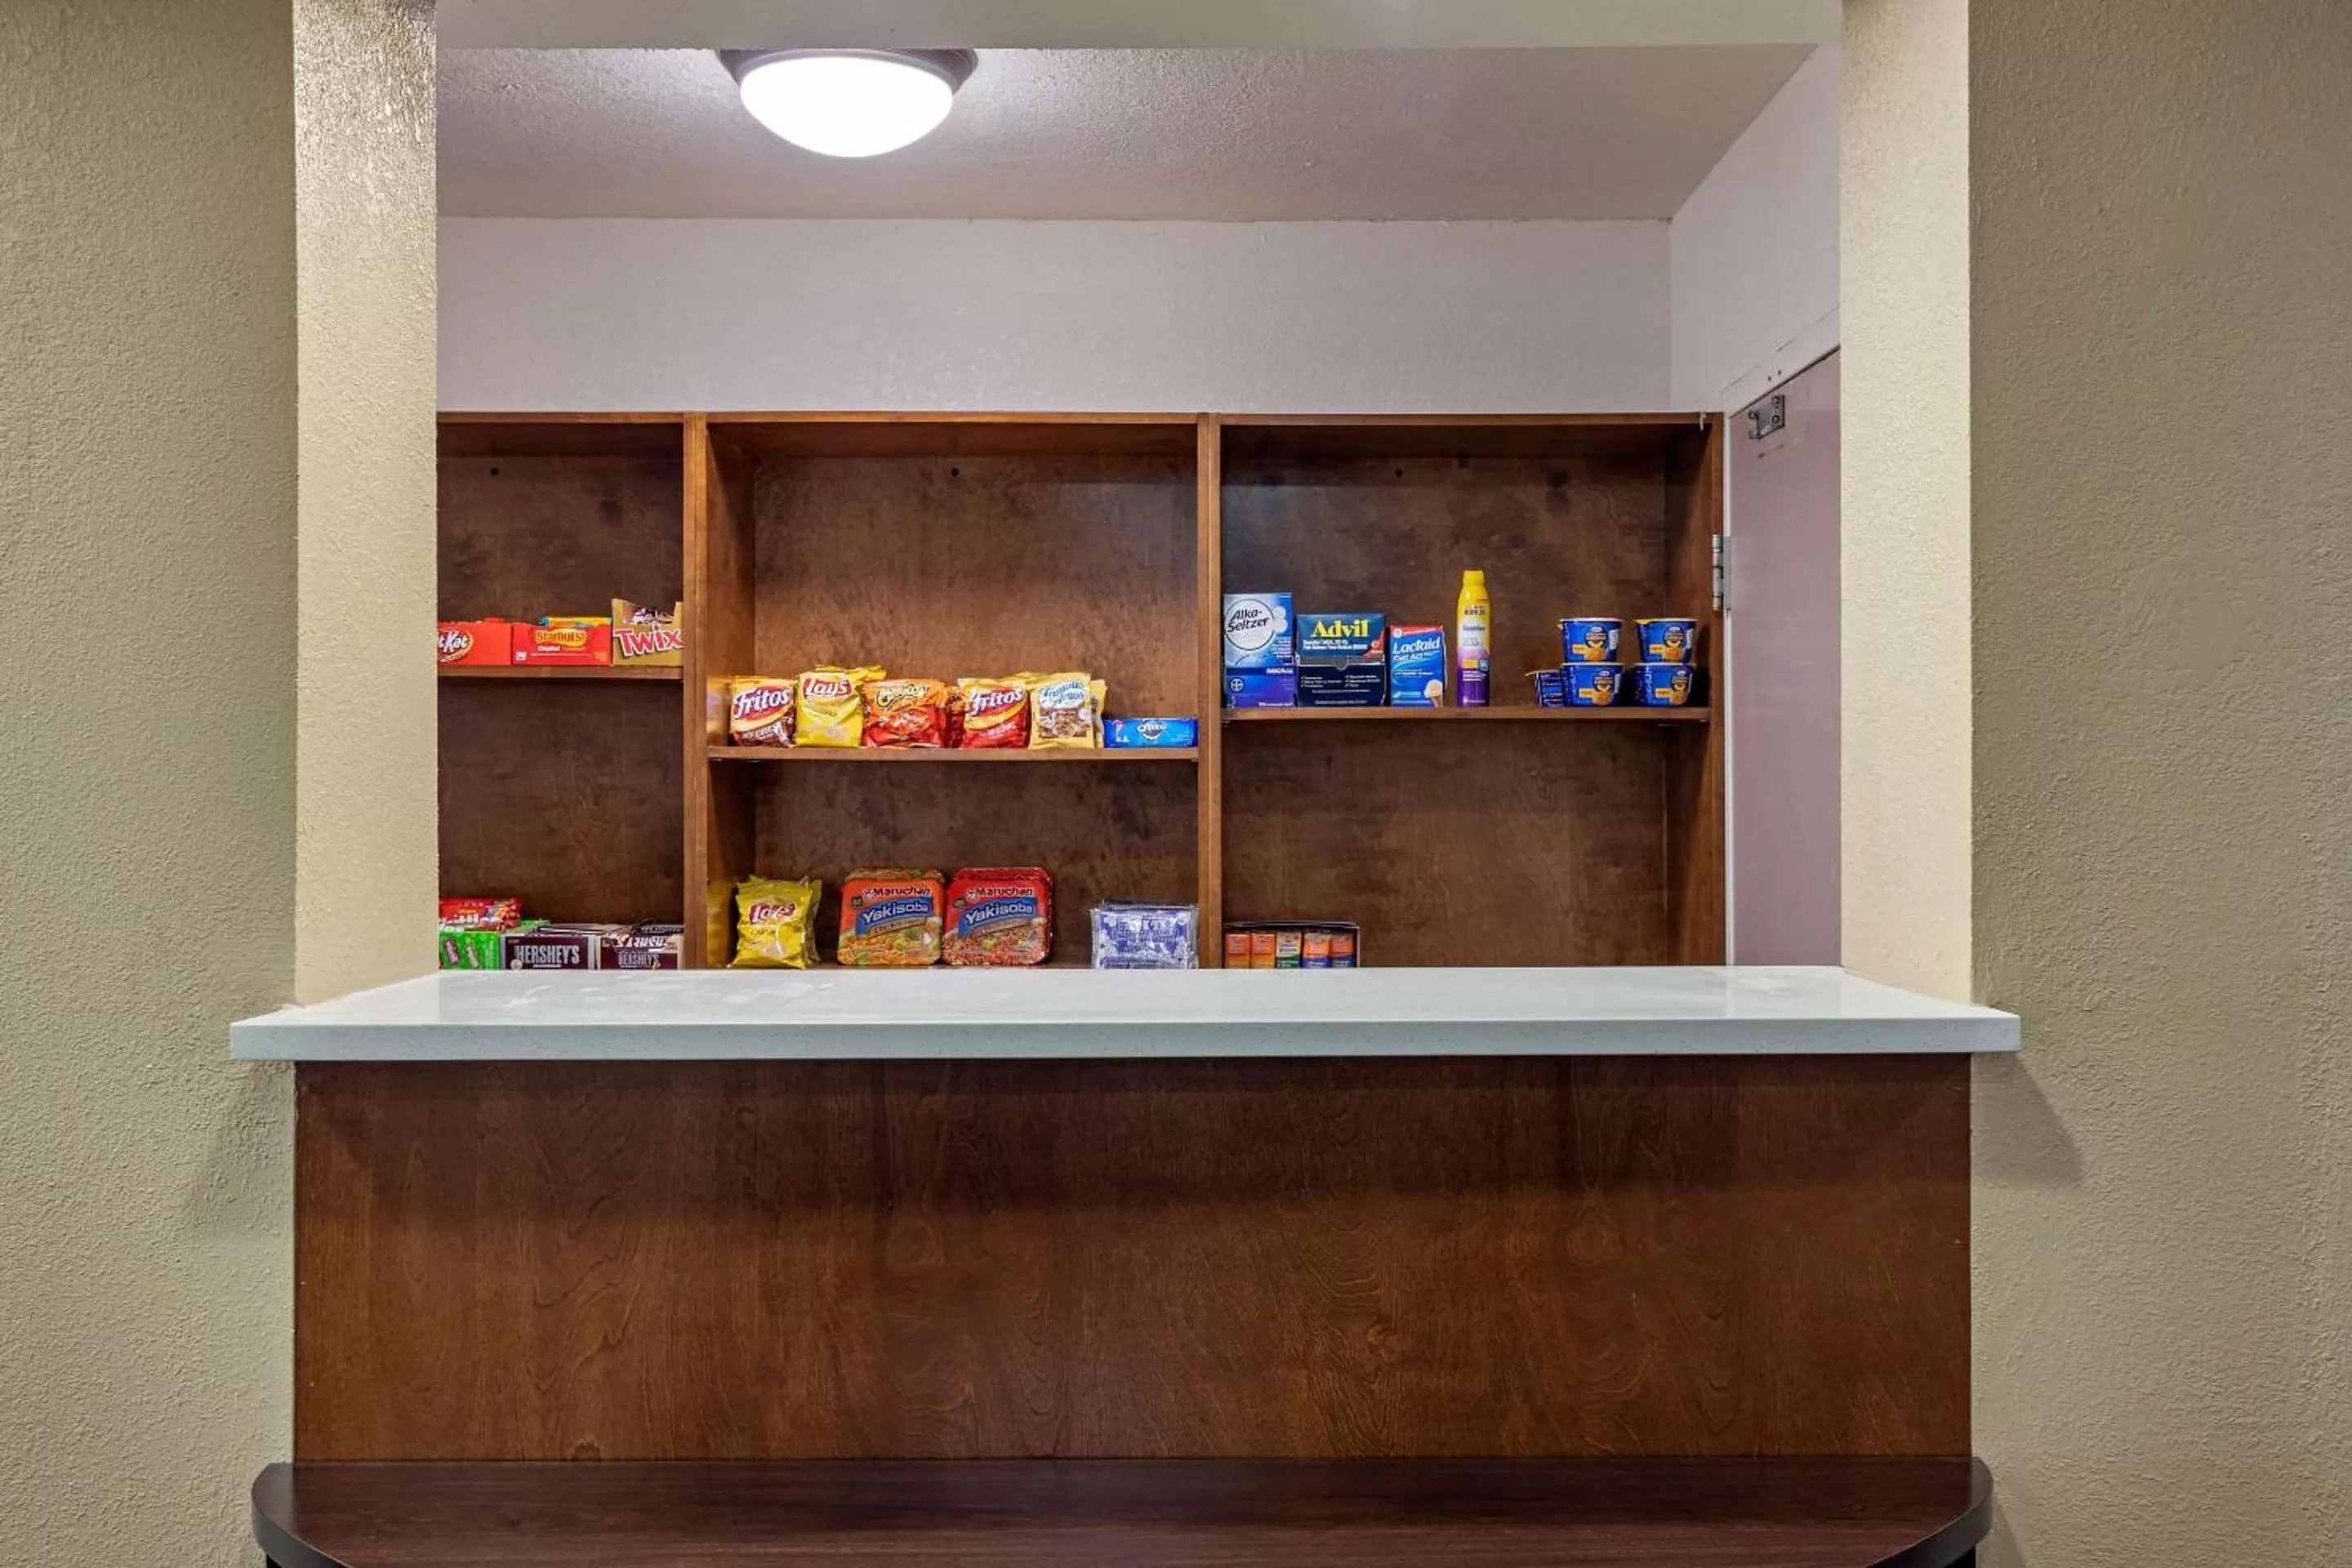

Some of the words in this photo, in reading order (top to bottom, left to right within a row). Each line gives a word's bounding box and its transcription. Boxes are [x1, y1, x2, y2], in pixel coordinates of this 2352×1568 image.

[1227, 617, 1270, 633] Seltzer
[1310, 619, 1368, 638] Advil
[1392, 636, 1441, 654] Lactaid
[733, 686, 790, 719] Fritos
[969, 687, 1023, 717] Fritos
[872, 887, 931, 896] Maruchan
[977, 887, 1032, 896] Maruchan
[862, 902, 929, 924] Yakisoba
[965, 903, 1032, 924] Yakisoba
[514, 945, 580, 964] HERSHEY'S
